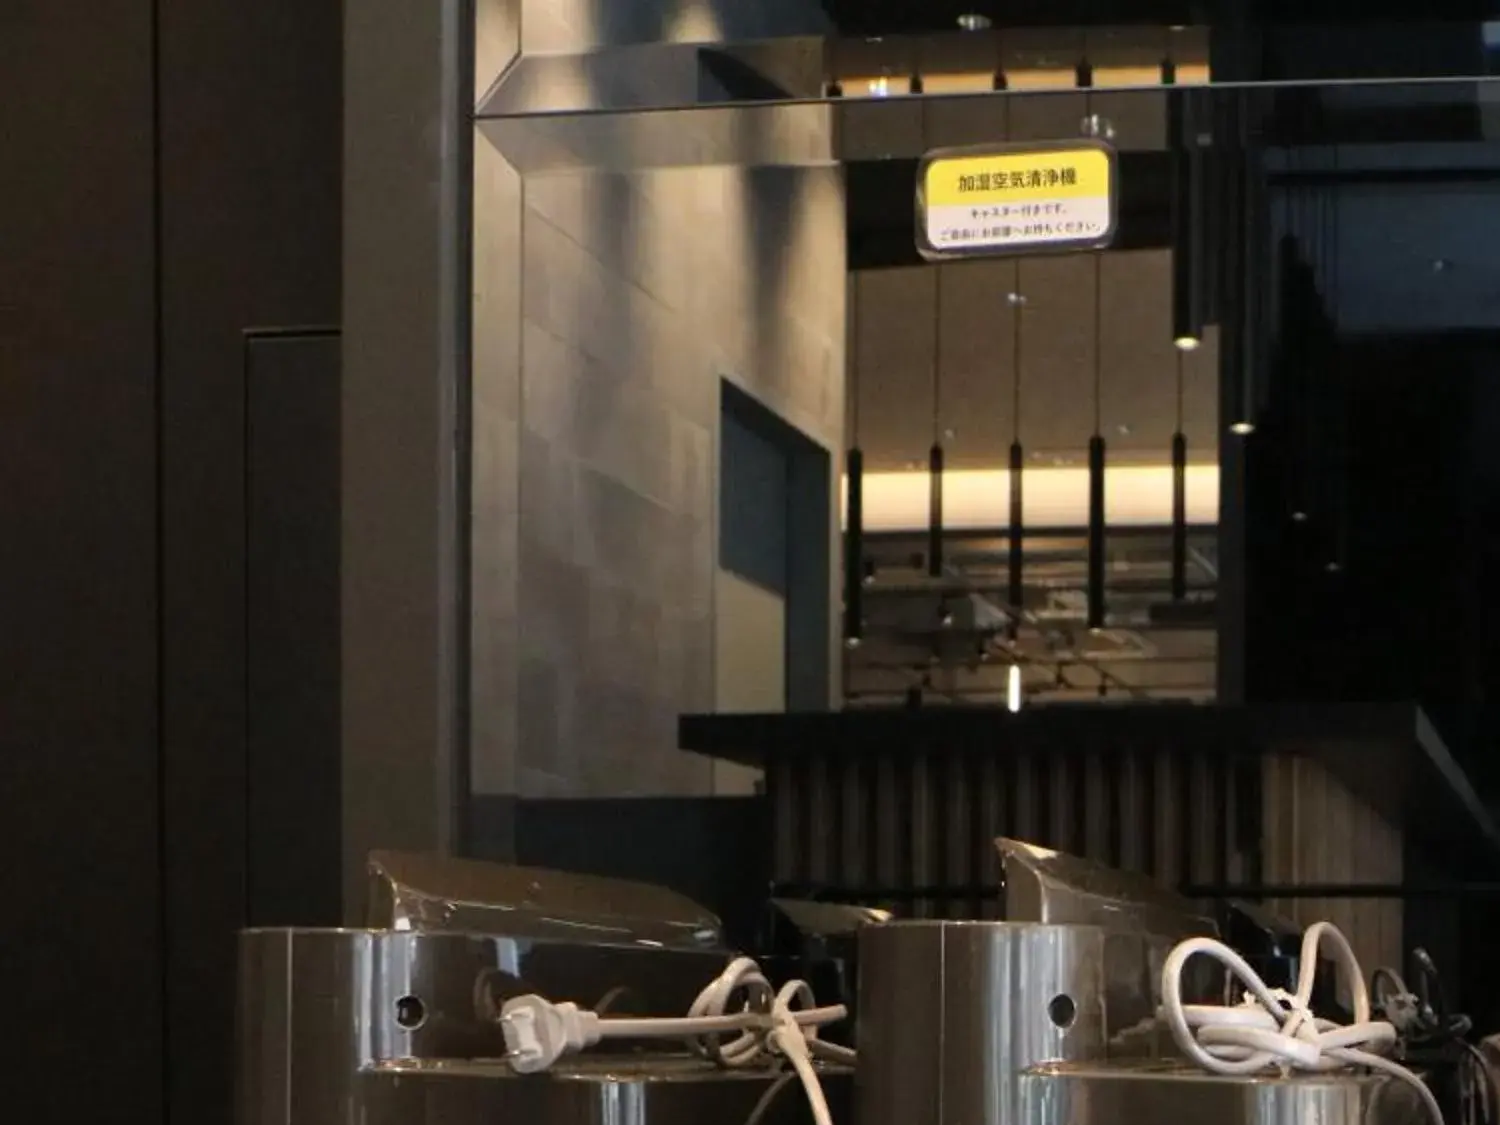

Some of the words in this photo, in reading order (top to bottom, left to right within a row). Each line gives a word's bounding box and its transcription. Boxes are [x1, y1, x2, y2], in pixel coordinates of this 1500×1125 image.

[958, 167, 1078, 193] 加湿空気清浄機
